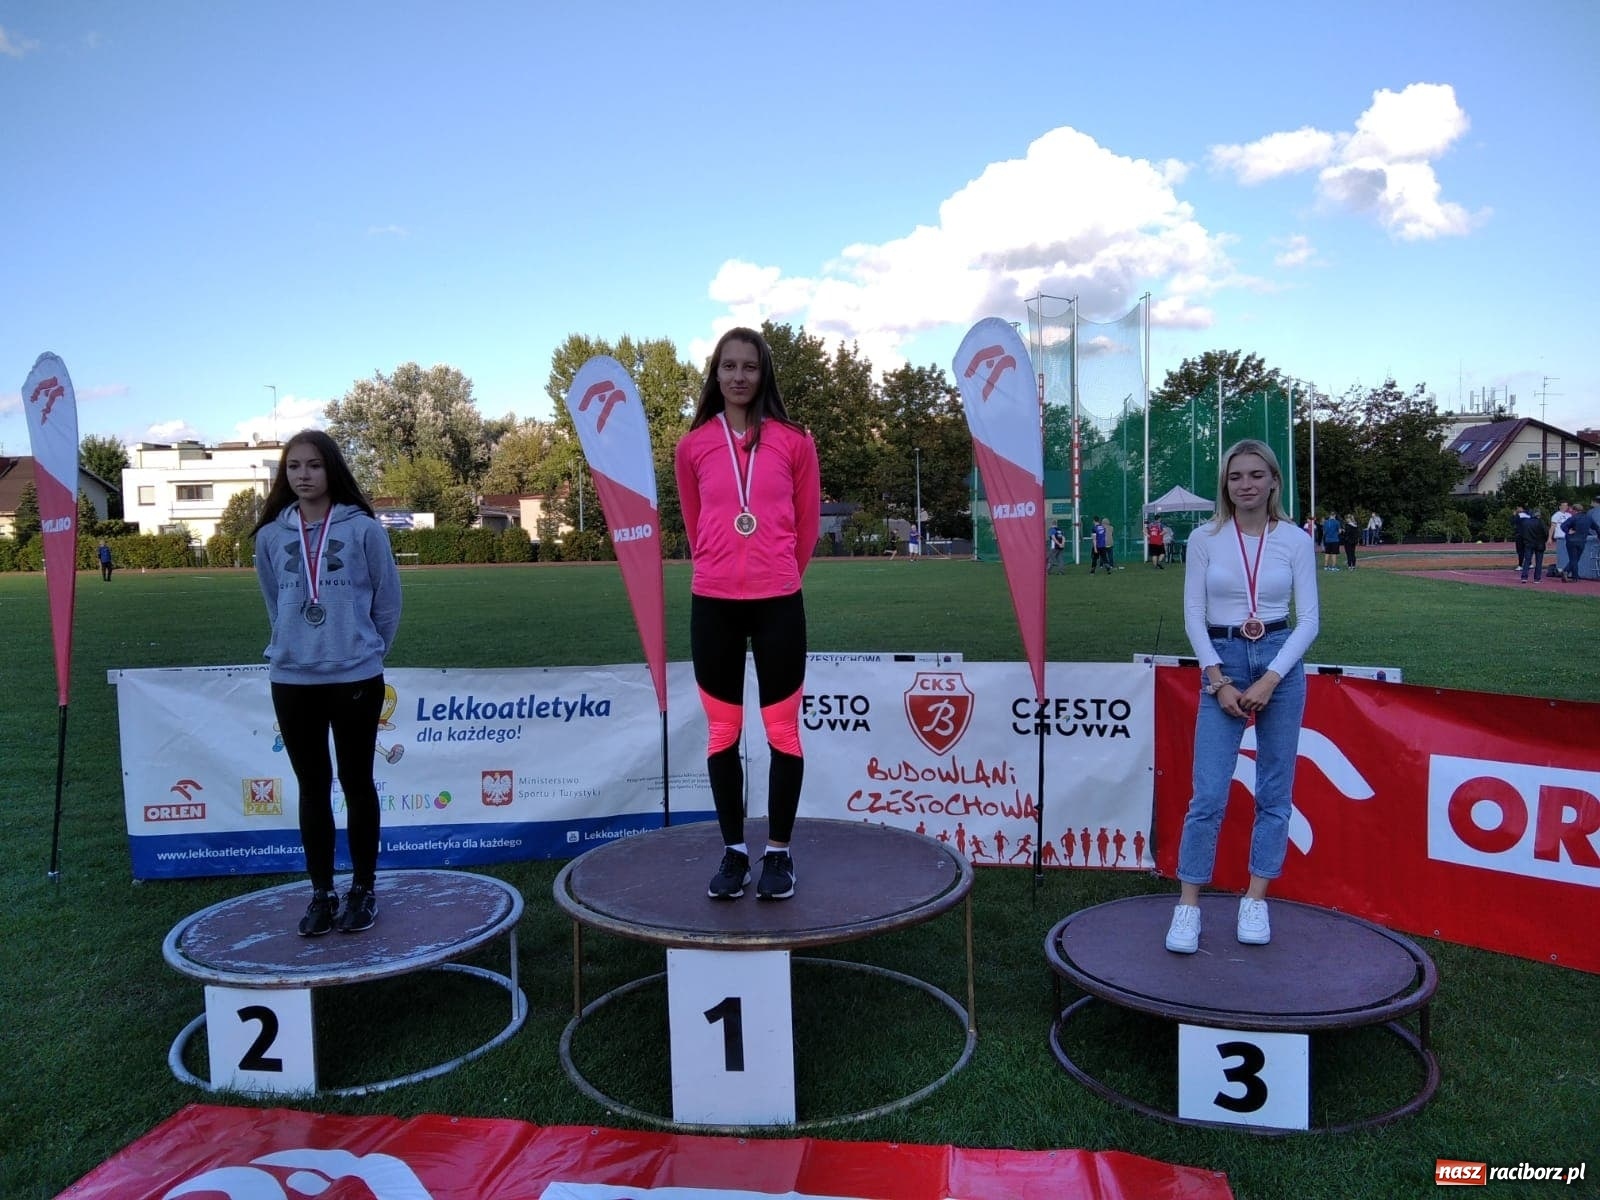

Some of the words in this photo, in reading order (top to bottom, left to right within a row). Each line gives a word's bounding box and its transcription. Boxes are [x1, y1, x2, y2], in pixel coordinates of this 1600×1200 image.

[919, 678, 956, 692] CKS
[416, 693, 611, 723] Lekkoatletyka
[416, 727, 443, 743] dla
[447, 725, 522, 743] każdego!
[519, 777, 580, 785] Ministerstwo
[518, 790, 549, 799] Sportu
[560, 787, 601, 798] Turystyki
[402, 794, 431, 811] KIDS
[146, 805, 202, 820] ORLEN
[1447, 775, 1600, 869] OR
[386, 838, 461, 852] Lekkoatletyka
[462, 839, 479, 849] dla
[479, 837, 523, 850] każdego
[237, 1005, 283, 1072] 2
[703, 996, 746, 1073] 1
[1213, 1041, 1269, 1113] 3
